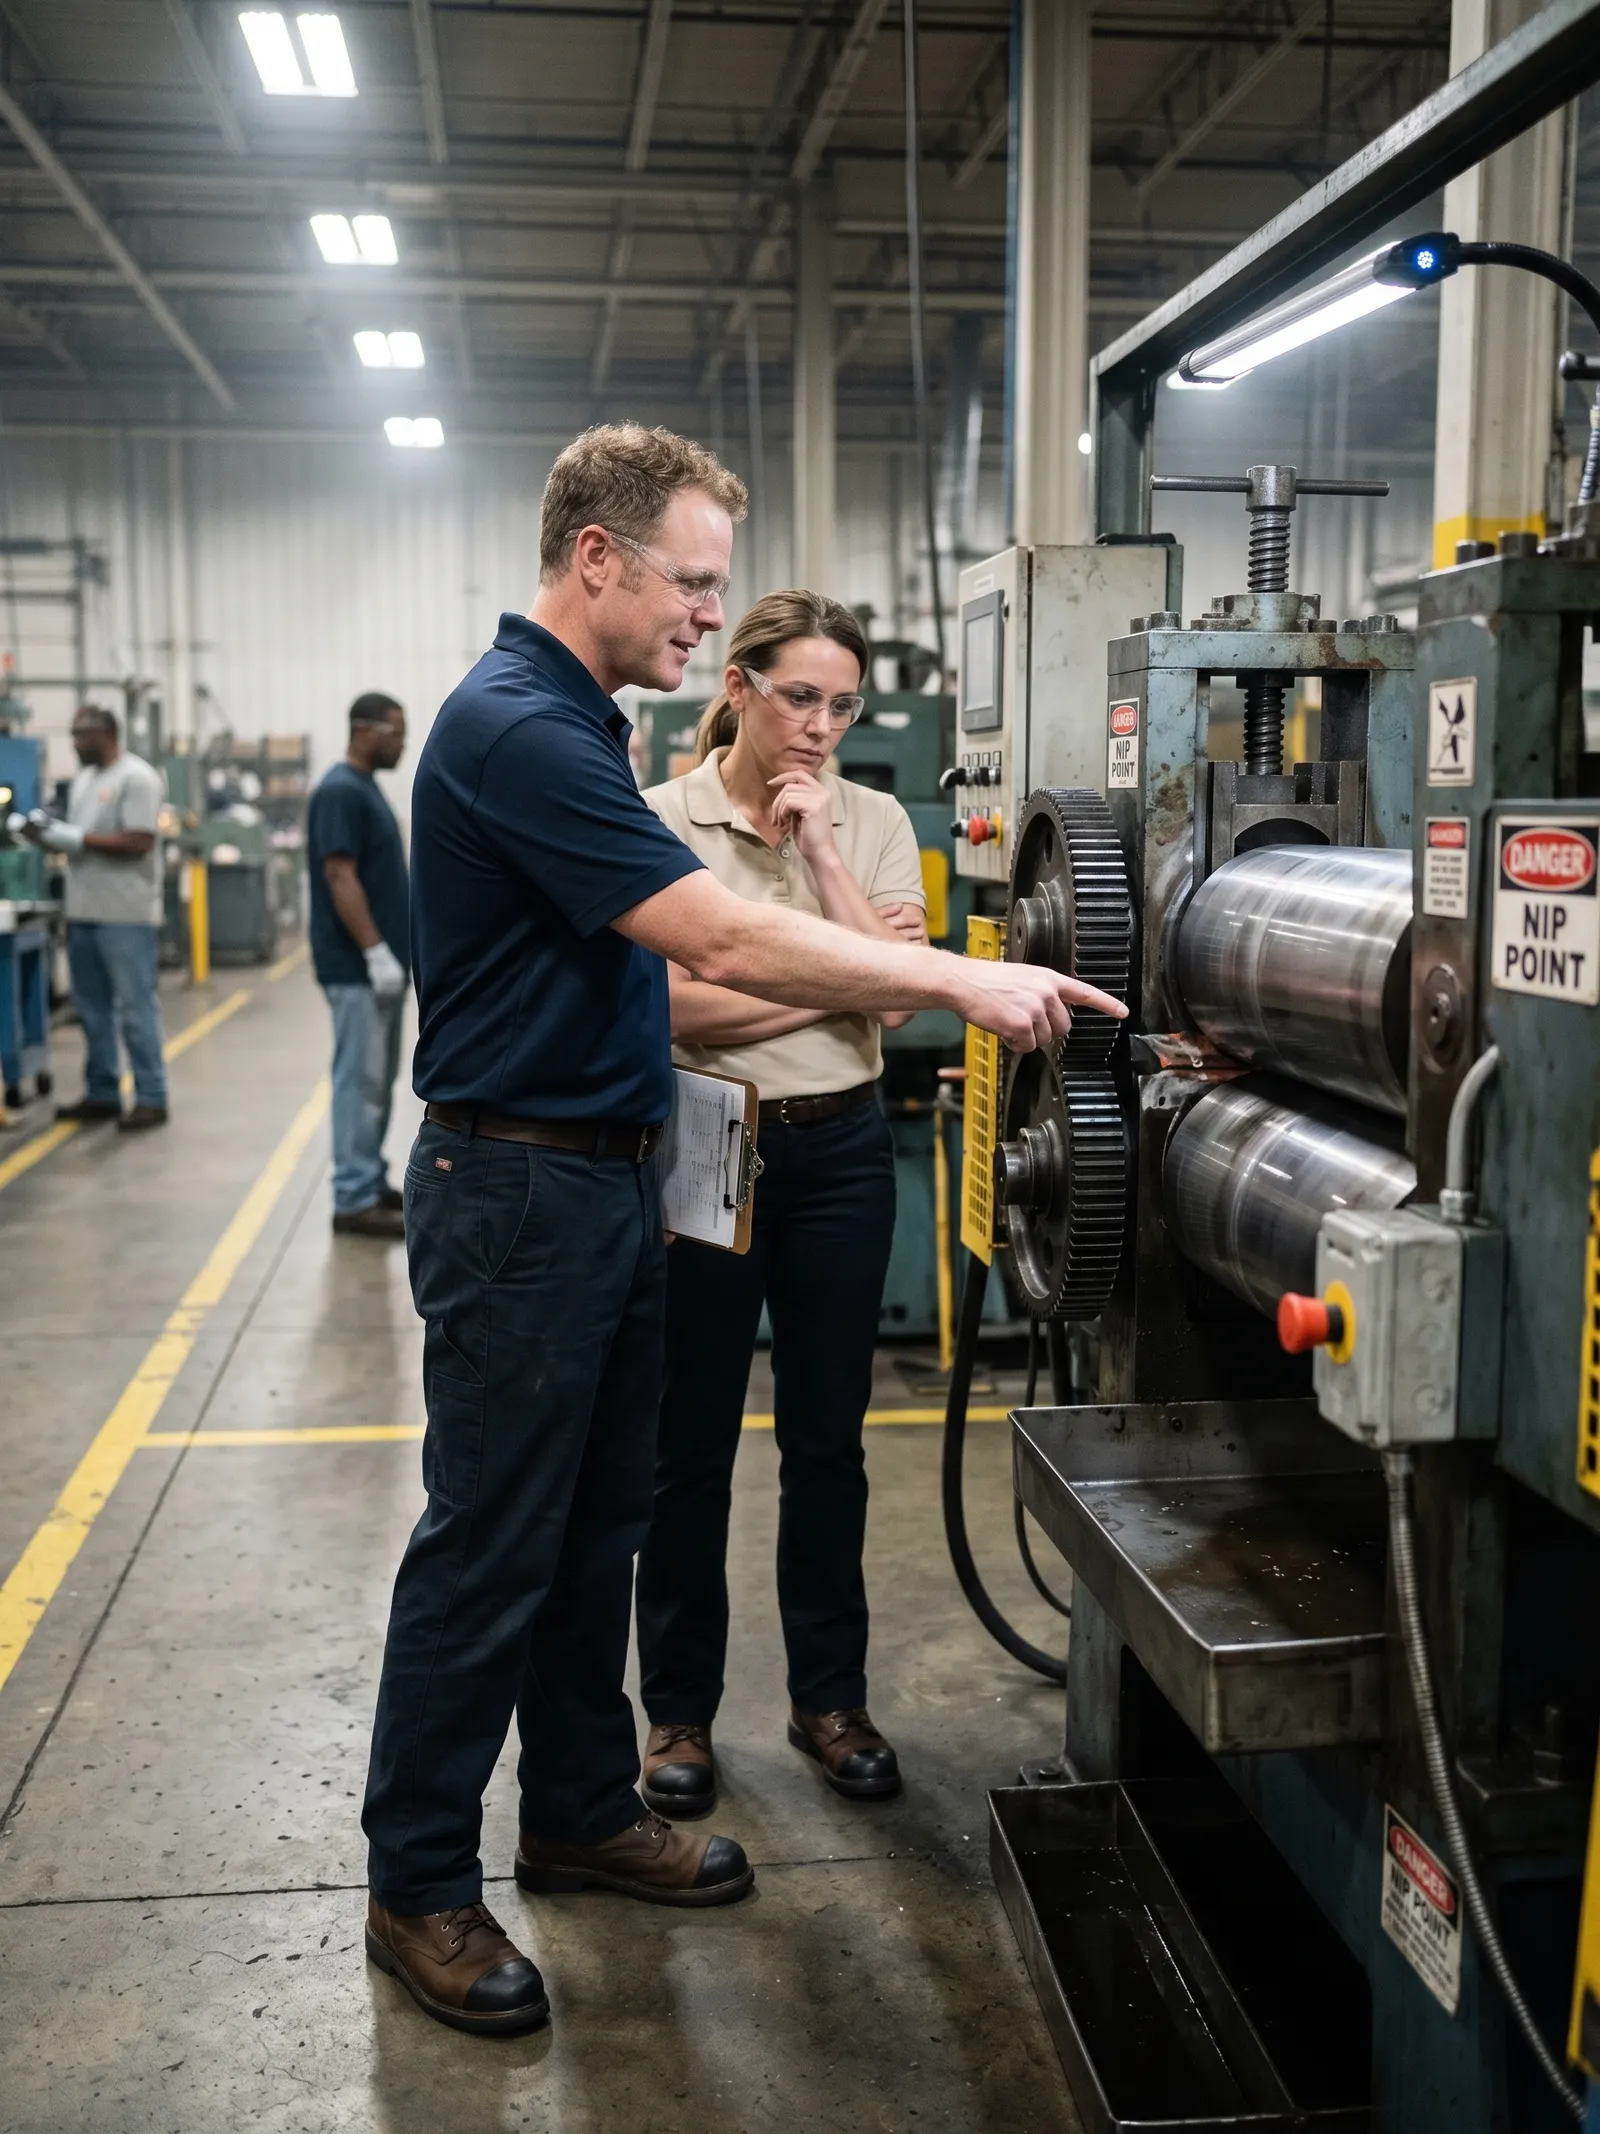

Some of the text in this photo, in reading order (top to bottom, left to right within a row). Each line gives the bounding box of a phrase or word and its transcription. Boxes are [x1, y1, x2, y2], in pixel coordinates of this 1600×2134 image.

[1116, 740, 1131, 760] NIP
[1112, 761, 1135, 778] POINT
[1508, 841, 1587, 878] DANGER
[1524, 903, 1567, 941] NIP
[1506, 945, 1585, 988] POINT
[1395, 1832, 1449, 1908] DANGER
[1391, 1863, 1410, 1898] NIP
[1413, 1891, 1452, 1948] POINT
